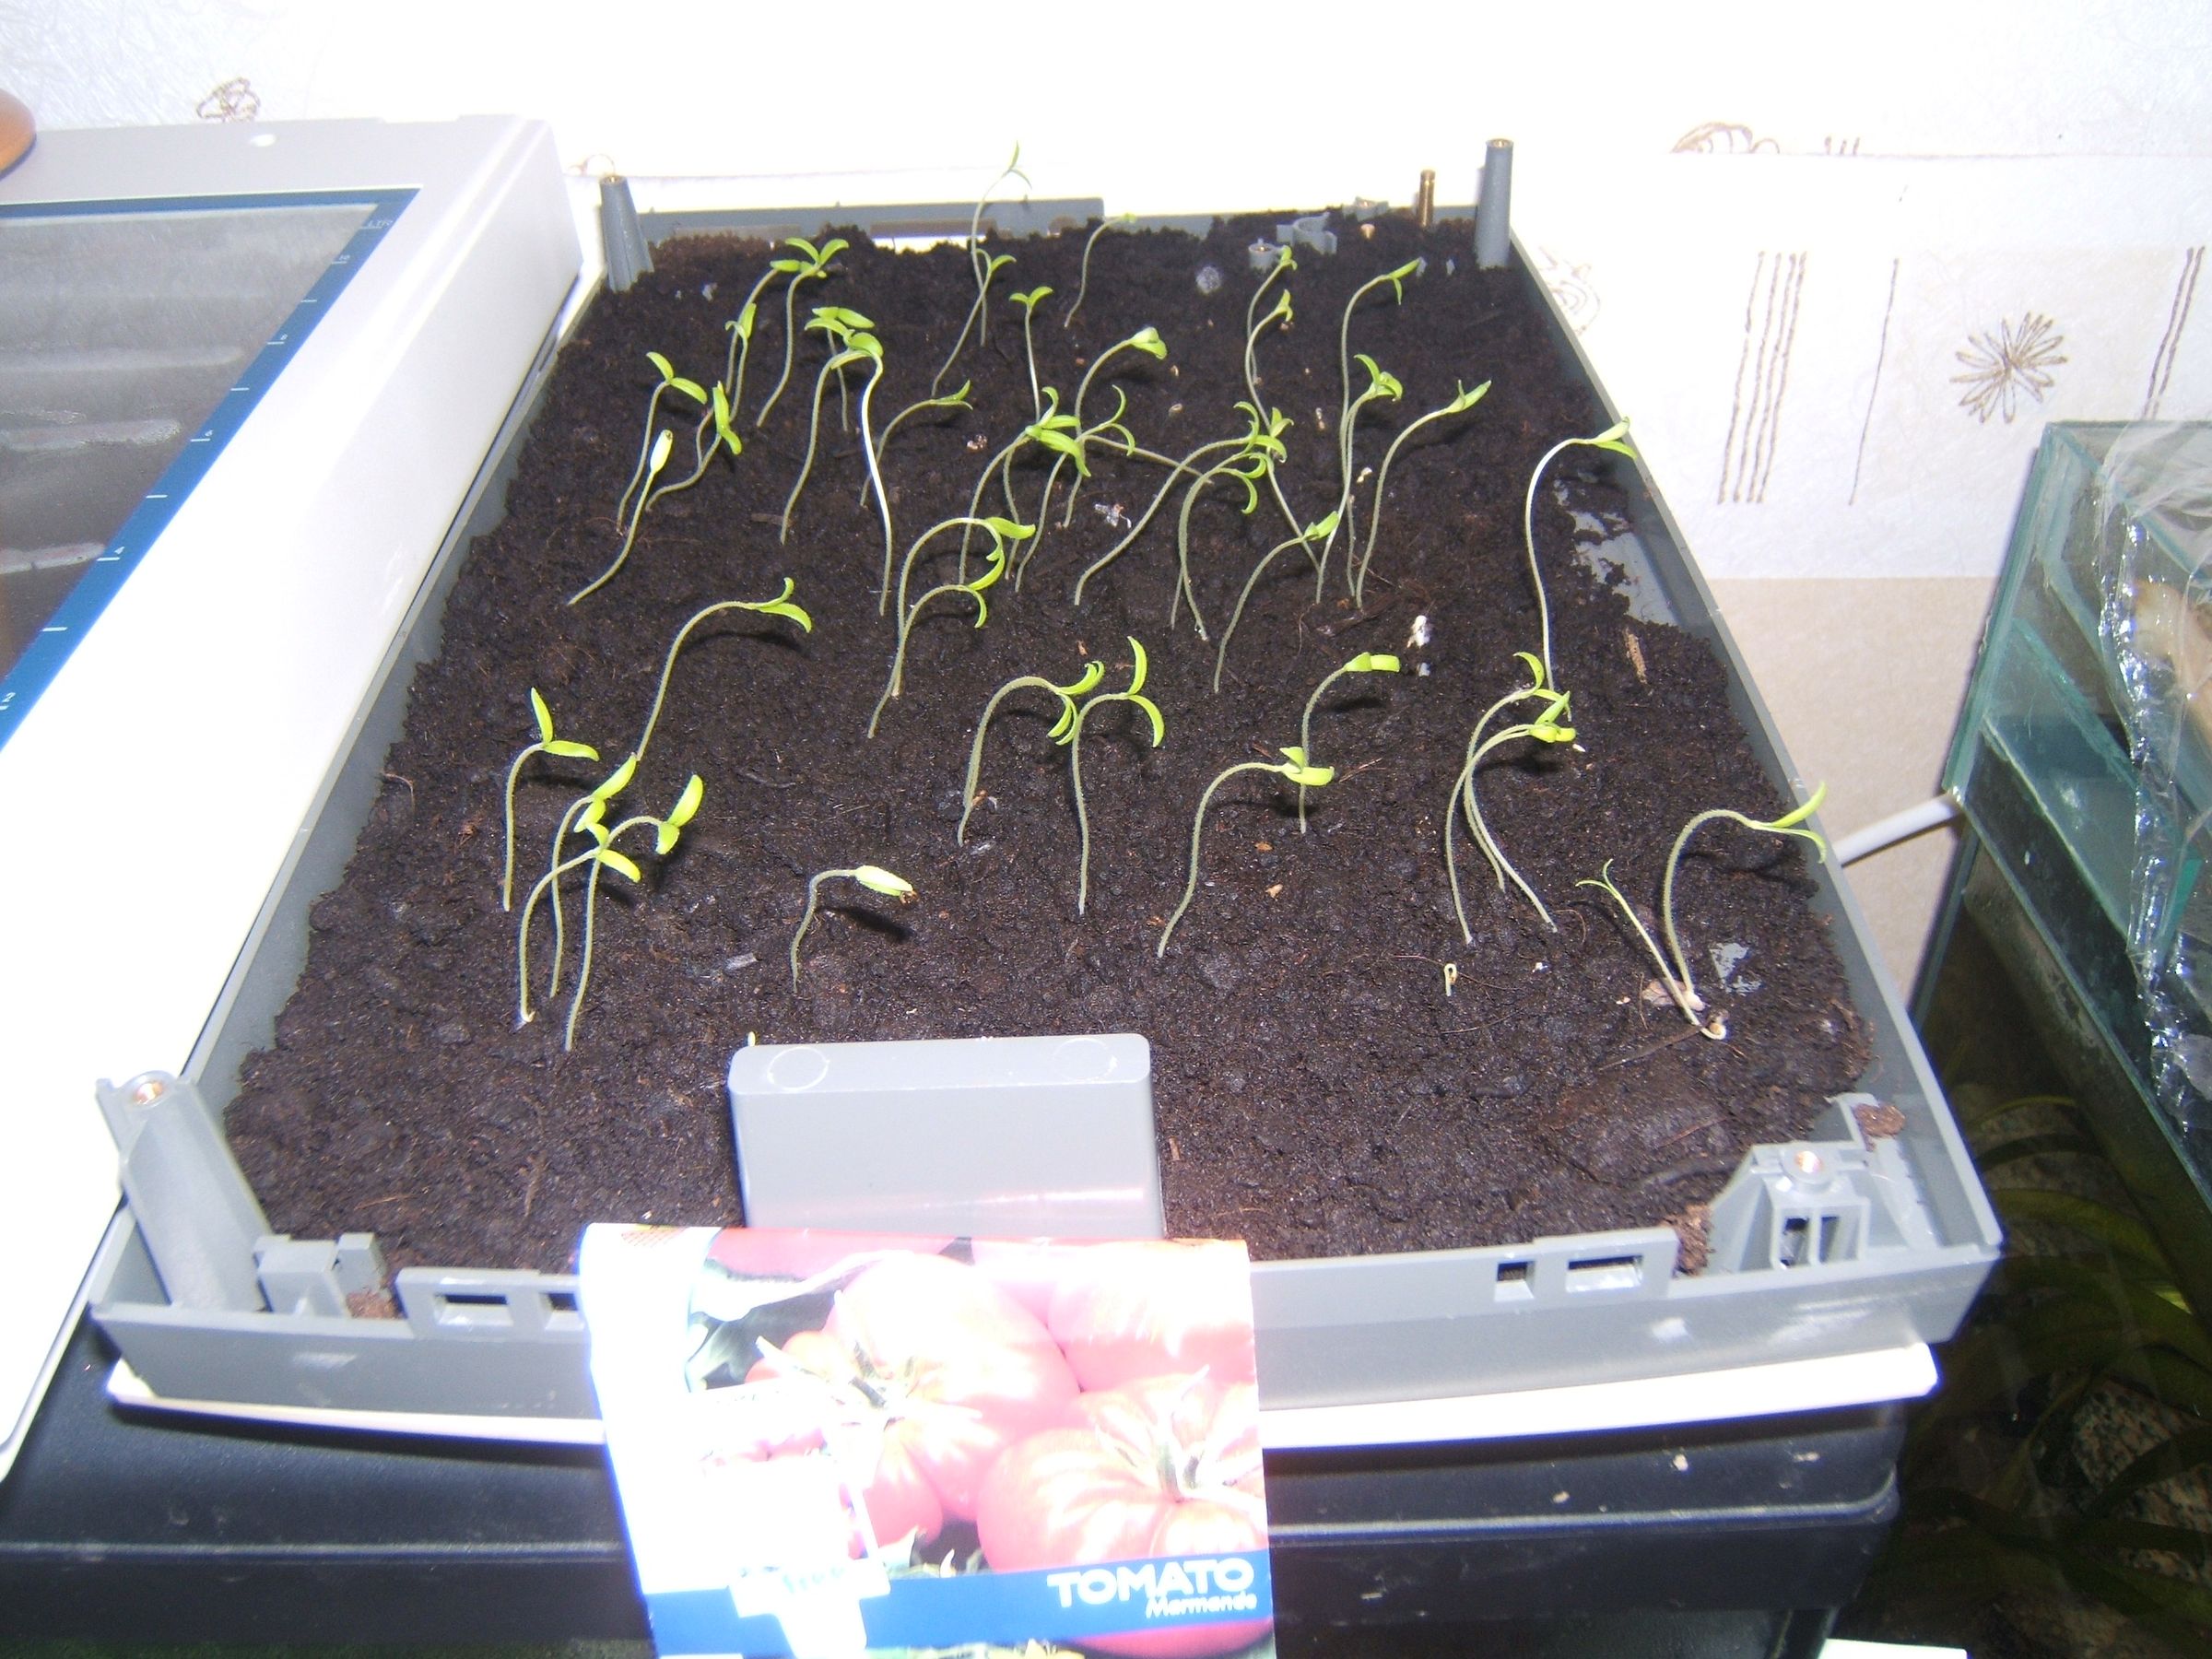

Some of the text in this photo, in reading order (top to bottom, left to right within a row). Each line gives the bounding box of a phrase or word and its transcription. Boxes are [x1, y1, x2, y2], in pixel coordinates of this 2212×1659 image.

[114, 546, 125, 554] 4
[2, 692, 16, 702] 2
[1047, 1558, 1254, 1607] TOMATO
[1146, 1592, 1257, 1618] Marmande
